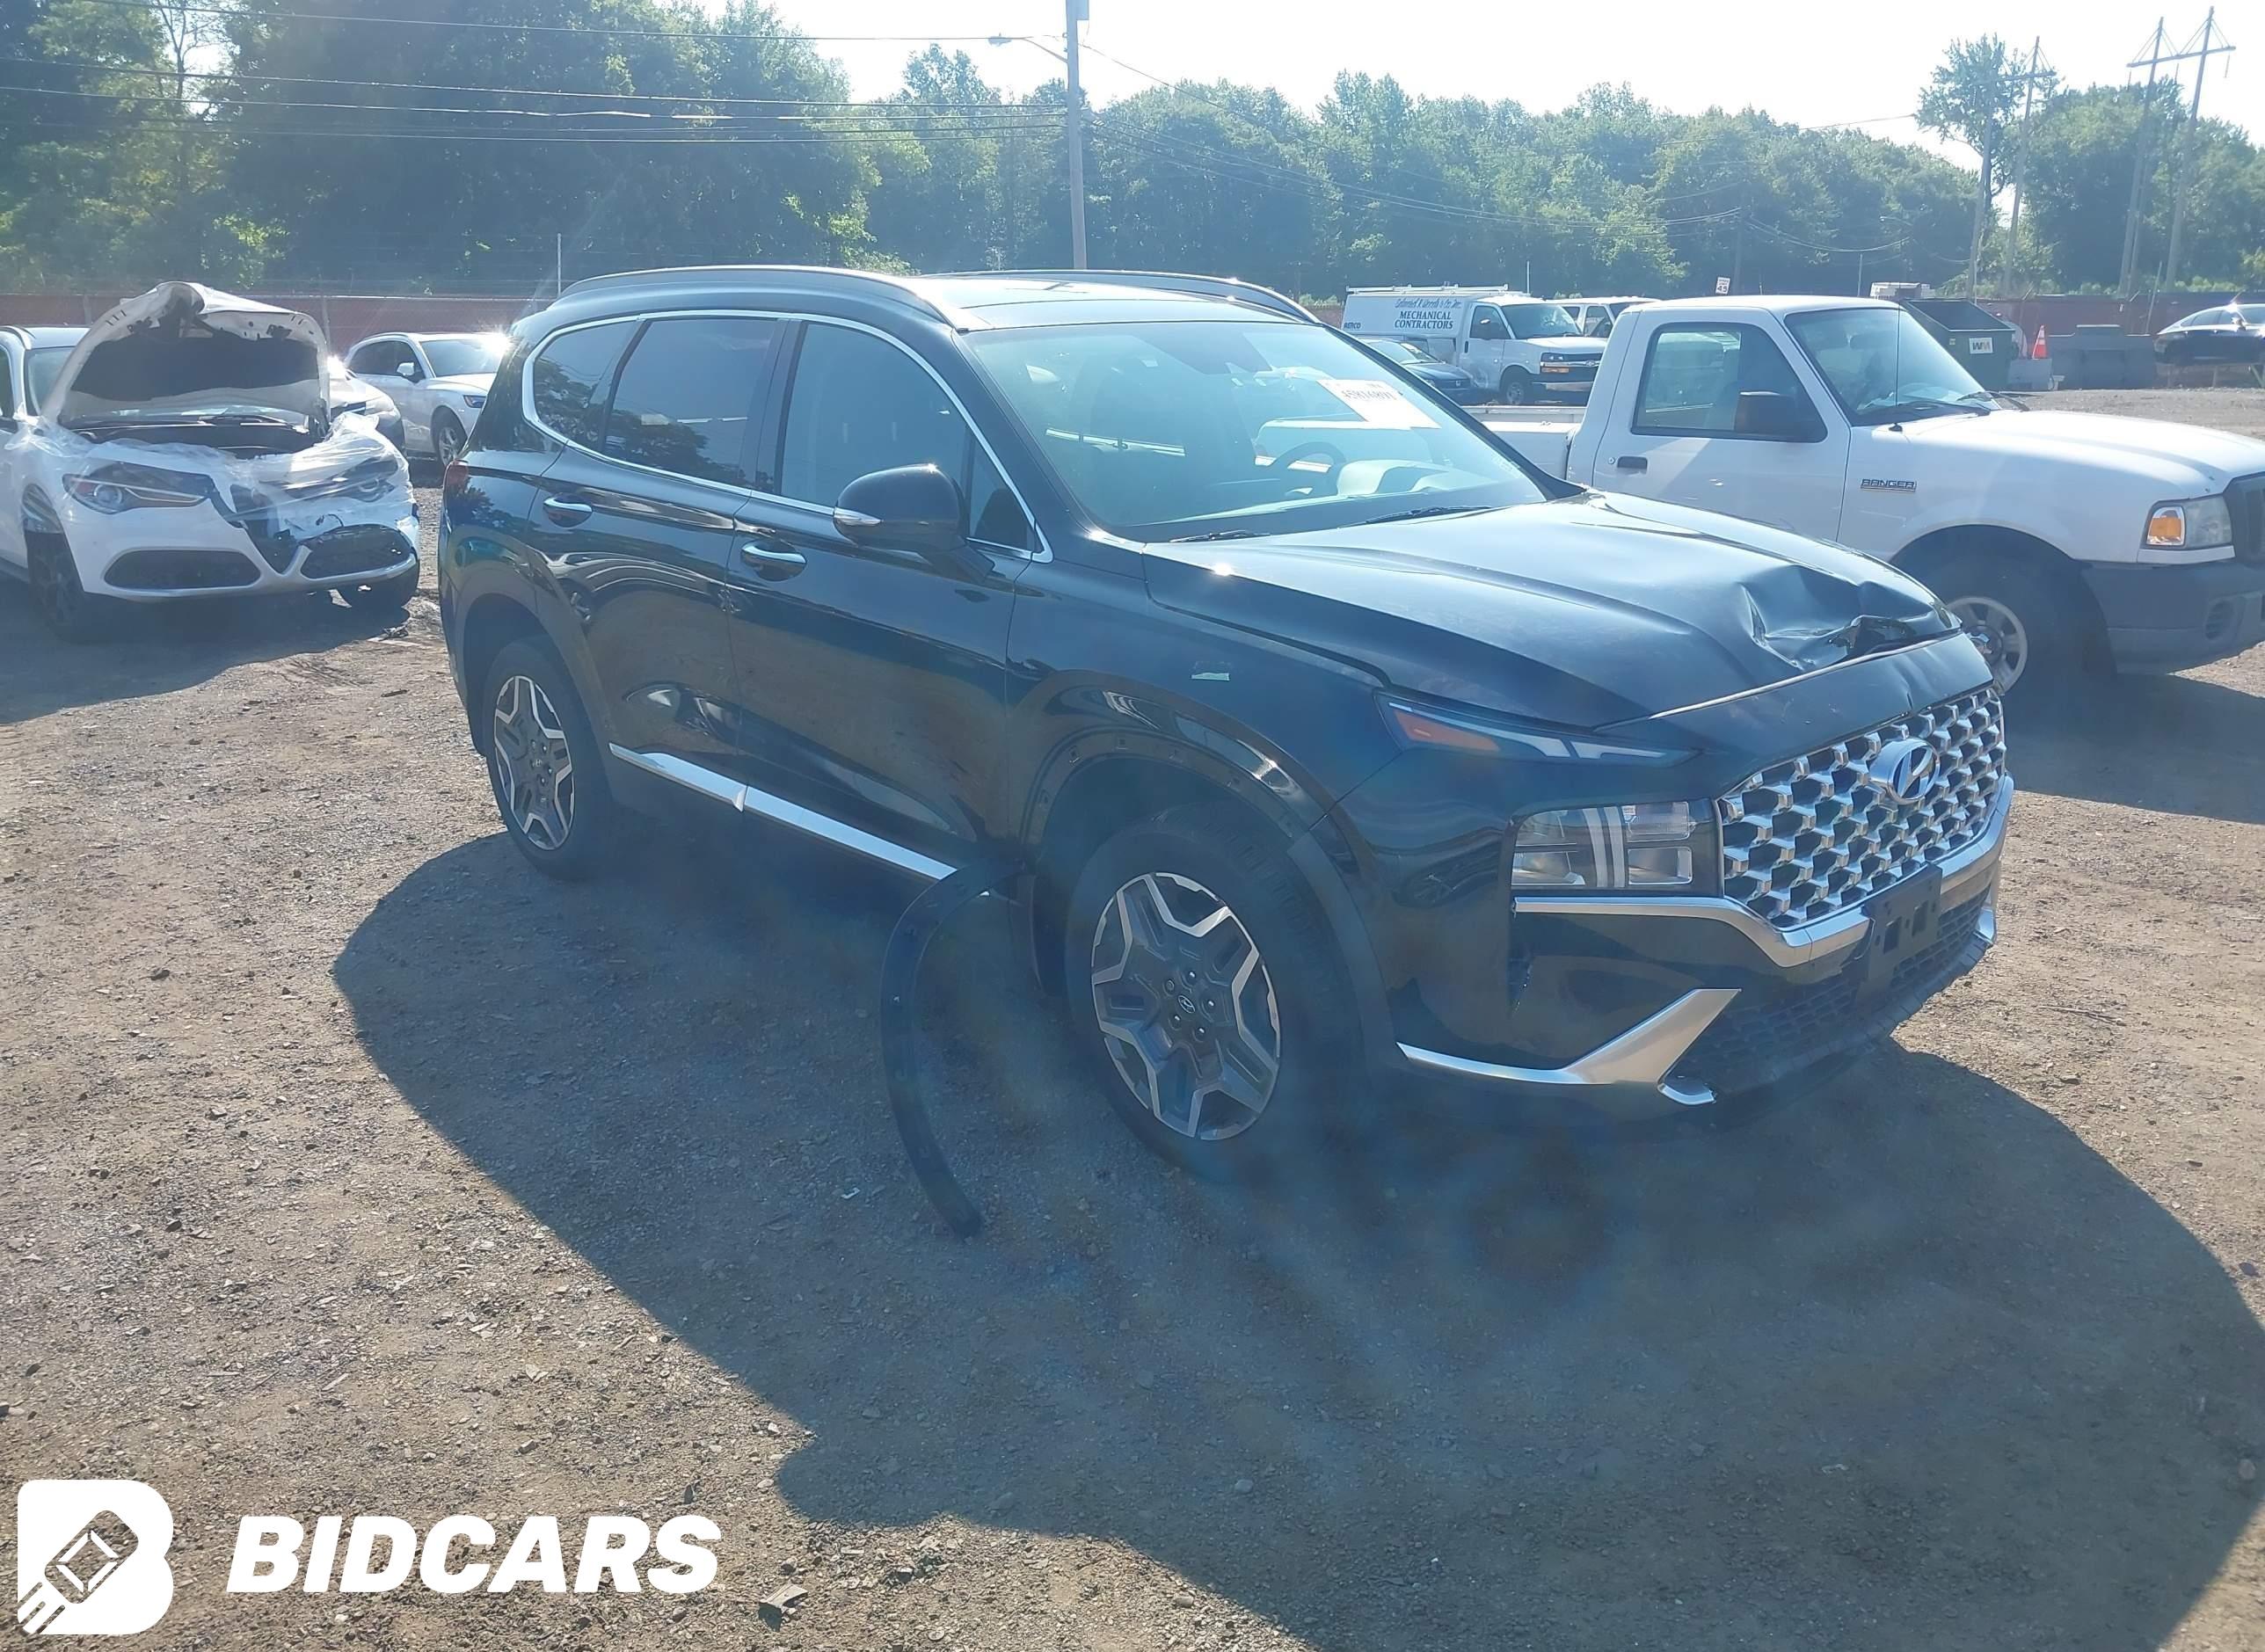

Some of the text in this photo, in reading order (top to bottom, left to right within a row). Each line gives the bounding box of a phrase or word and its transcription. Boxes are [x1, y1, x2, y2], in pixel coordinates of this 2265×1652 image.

[1399, 310, 1452, 320] MECHANICAL
[1394, 319, 1454, 330] CONTRACTORS
[1861, 478, 1915, 490] RANGER
